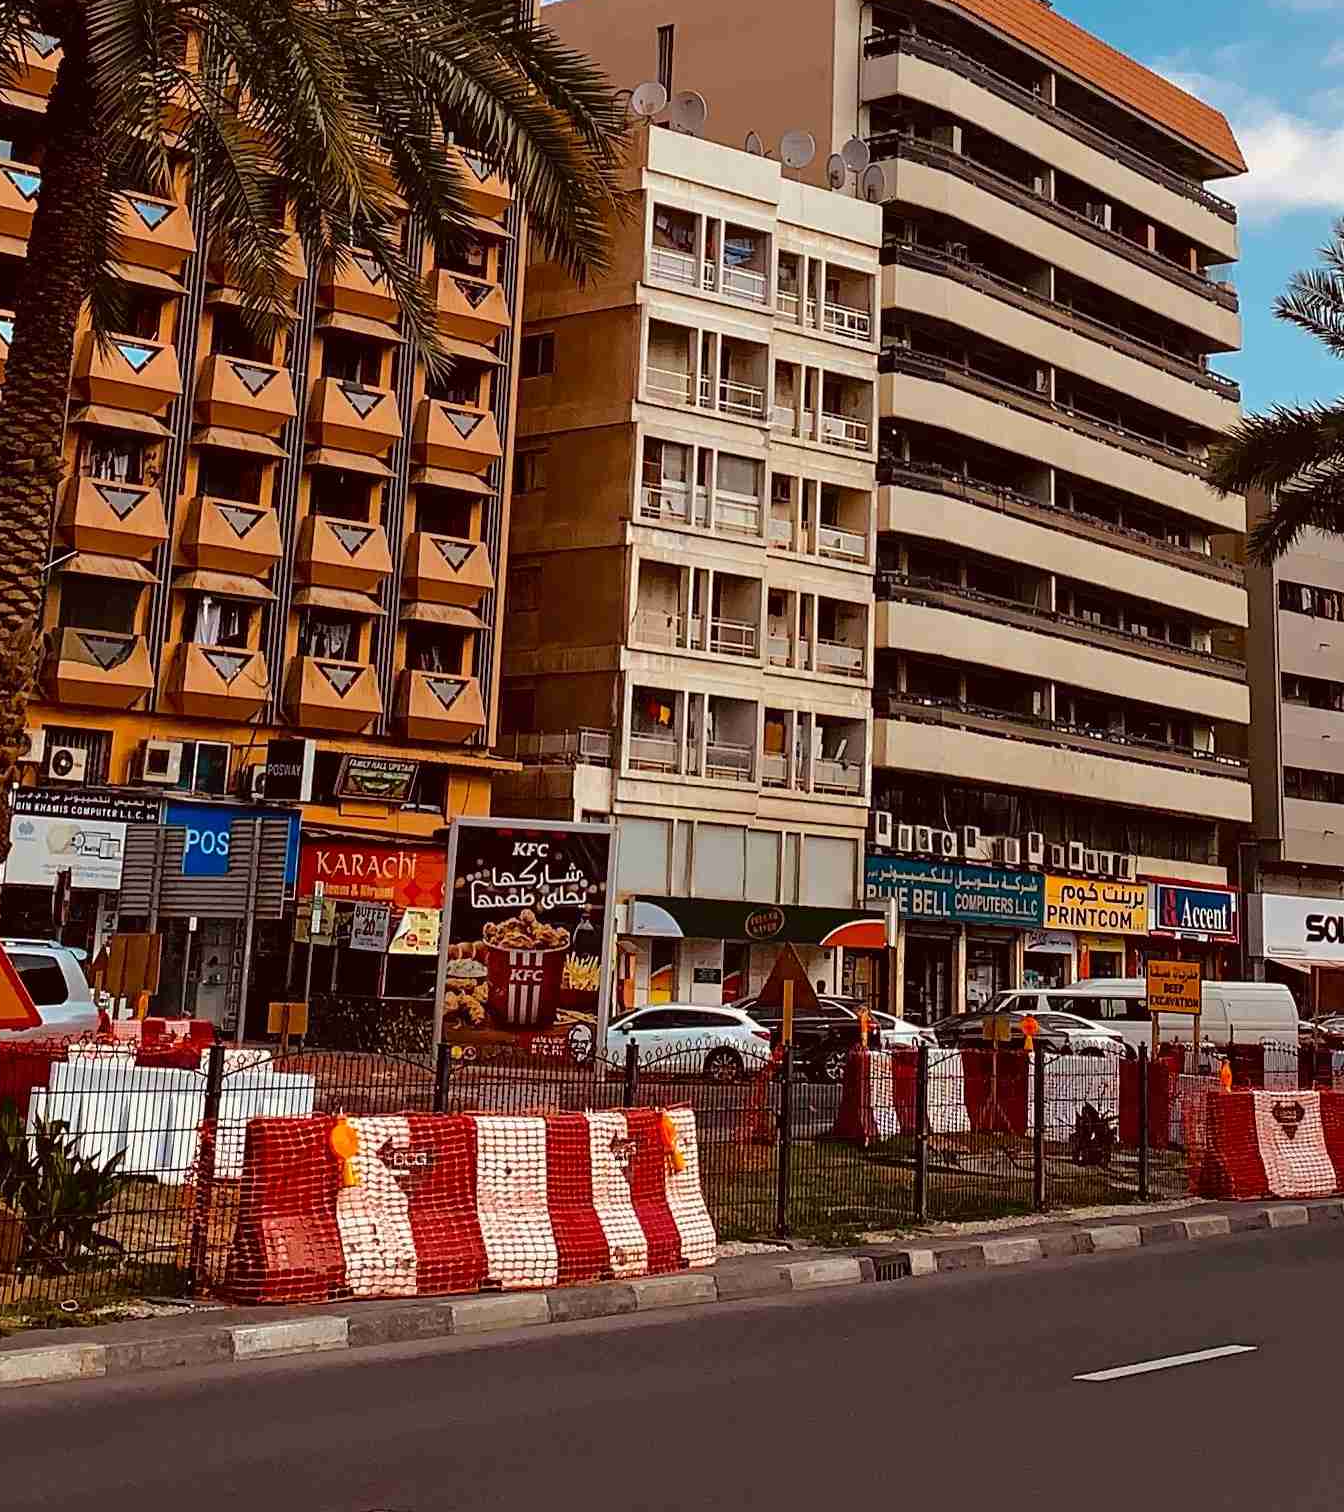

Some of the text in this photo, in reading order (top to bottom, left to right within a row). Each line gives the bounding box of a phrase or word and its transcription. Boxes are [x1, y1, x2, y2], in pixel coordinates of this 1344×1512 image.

[34, 802, 69, 814] KHAMIS
[71, 806, 117, 818] COMPUTER
[185, 829, 230, 856] POS
[512, 842, 549, 857] KFC
[492, 859, 584, 888] شاركها
[471, 880, 535, 908] طعمها
[912, 888, 951, 916] BELL
[954, 892, 1014, 913] COMPUTERS
[1061, 882, 1099, 905] كوم
[1047, 904, 1132, 930] PRINTCOM
[1181, 896, 1228, 930] Accent
[510, 969, 544, 982] KFC
[1164, 982, 1185, 994] DEEP
[1150, 996, 1200, 1008] EXCAVATION
